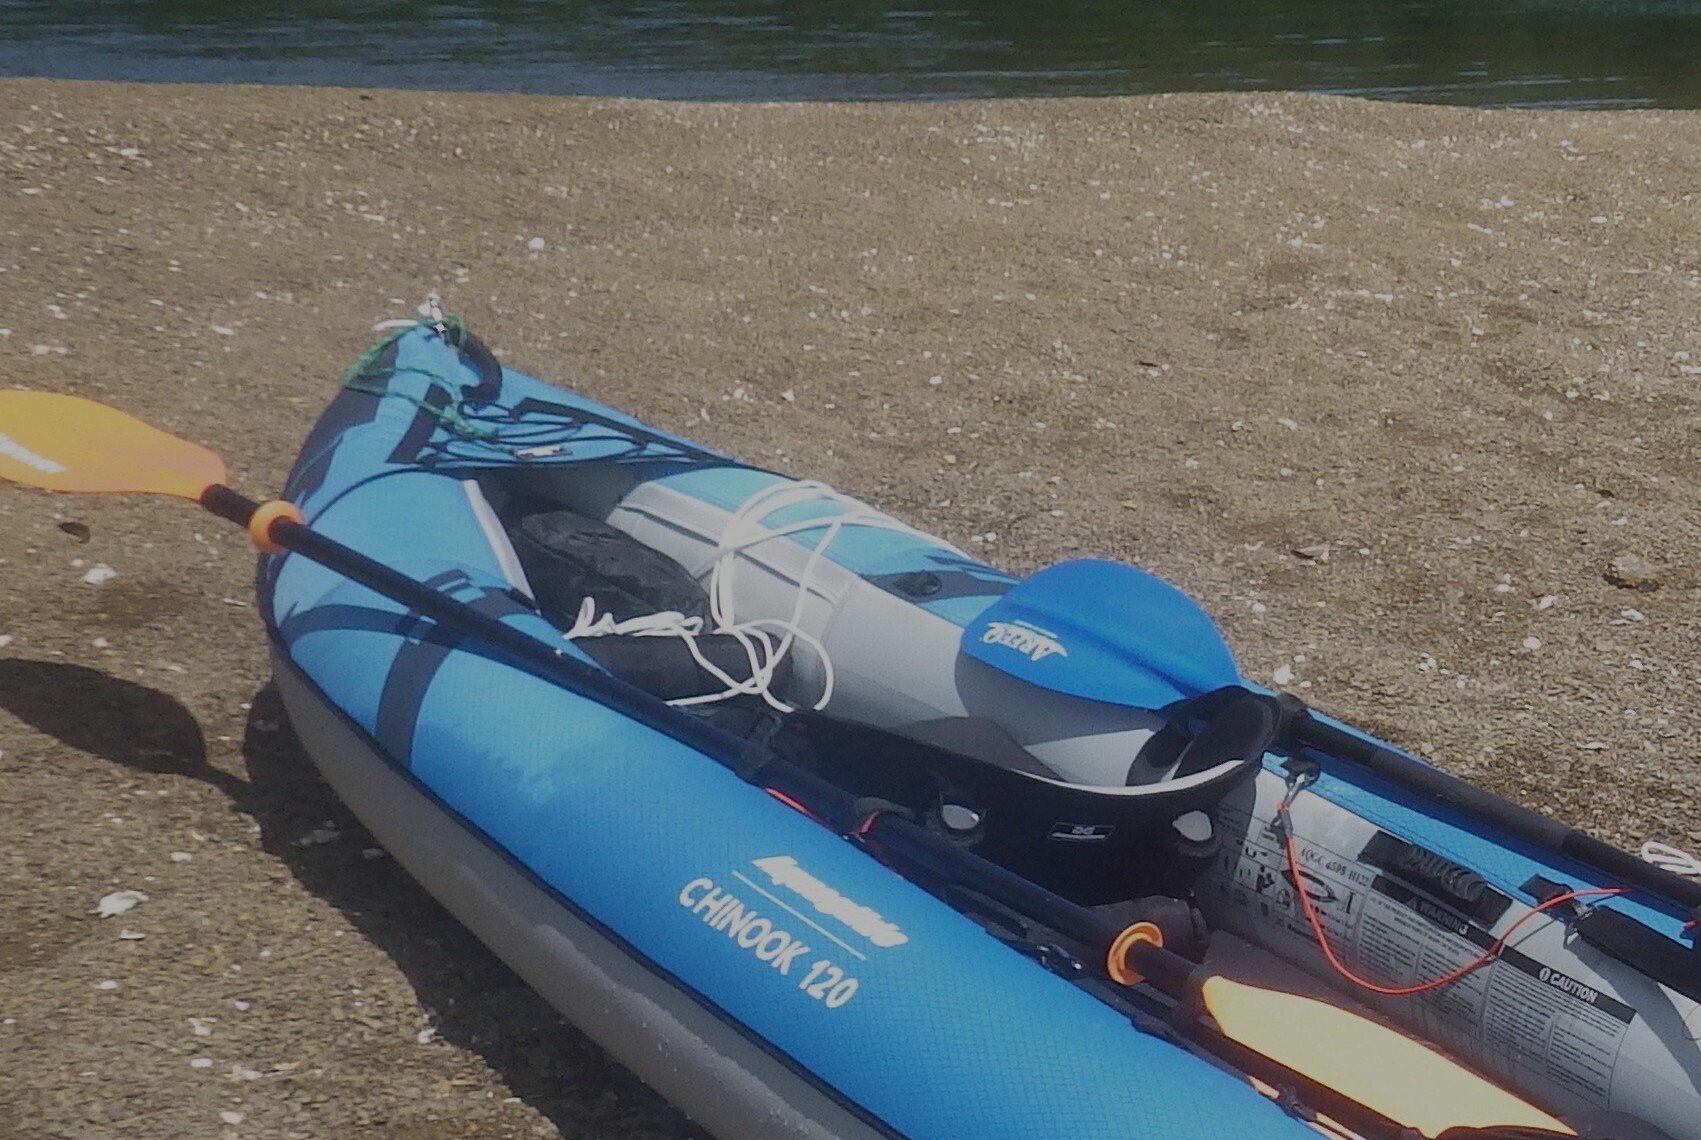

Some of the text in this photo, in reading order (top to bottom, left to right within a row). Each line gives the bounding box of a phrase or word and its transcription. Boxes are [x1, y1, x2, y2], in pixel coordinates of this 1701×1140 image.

[677, 877, 811, 976] CHINOOK
[798, 959, 860, 1009] 120
[1550, 972, 1599, 1004] CAUTION
